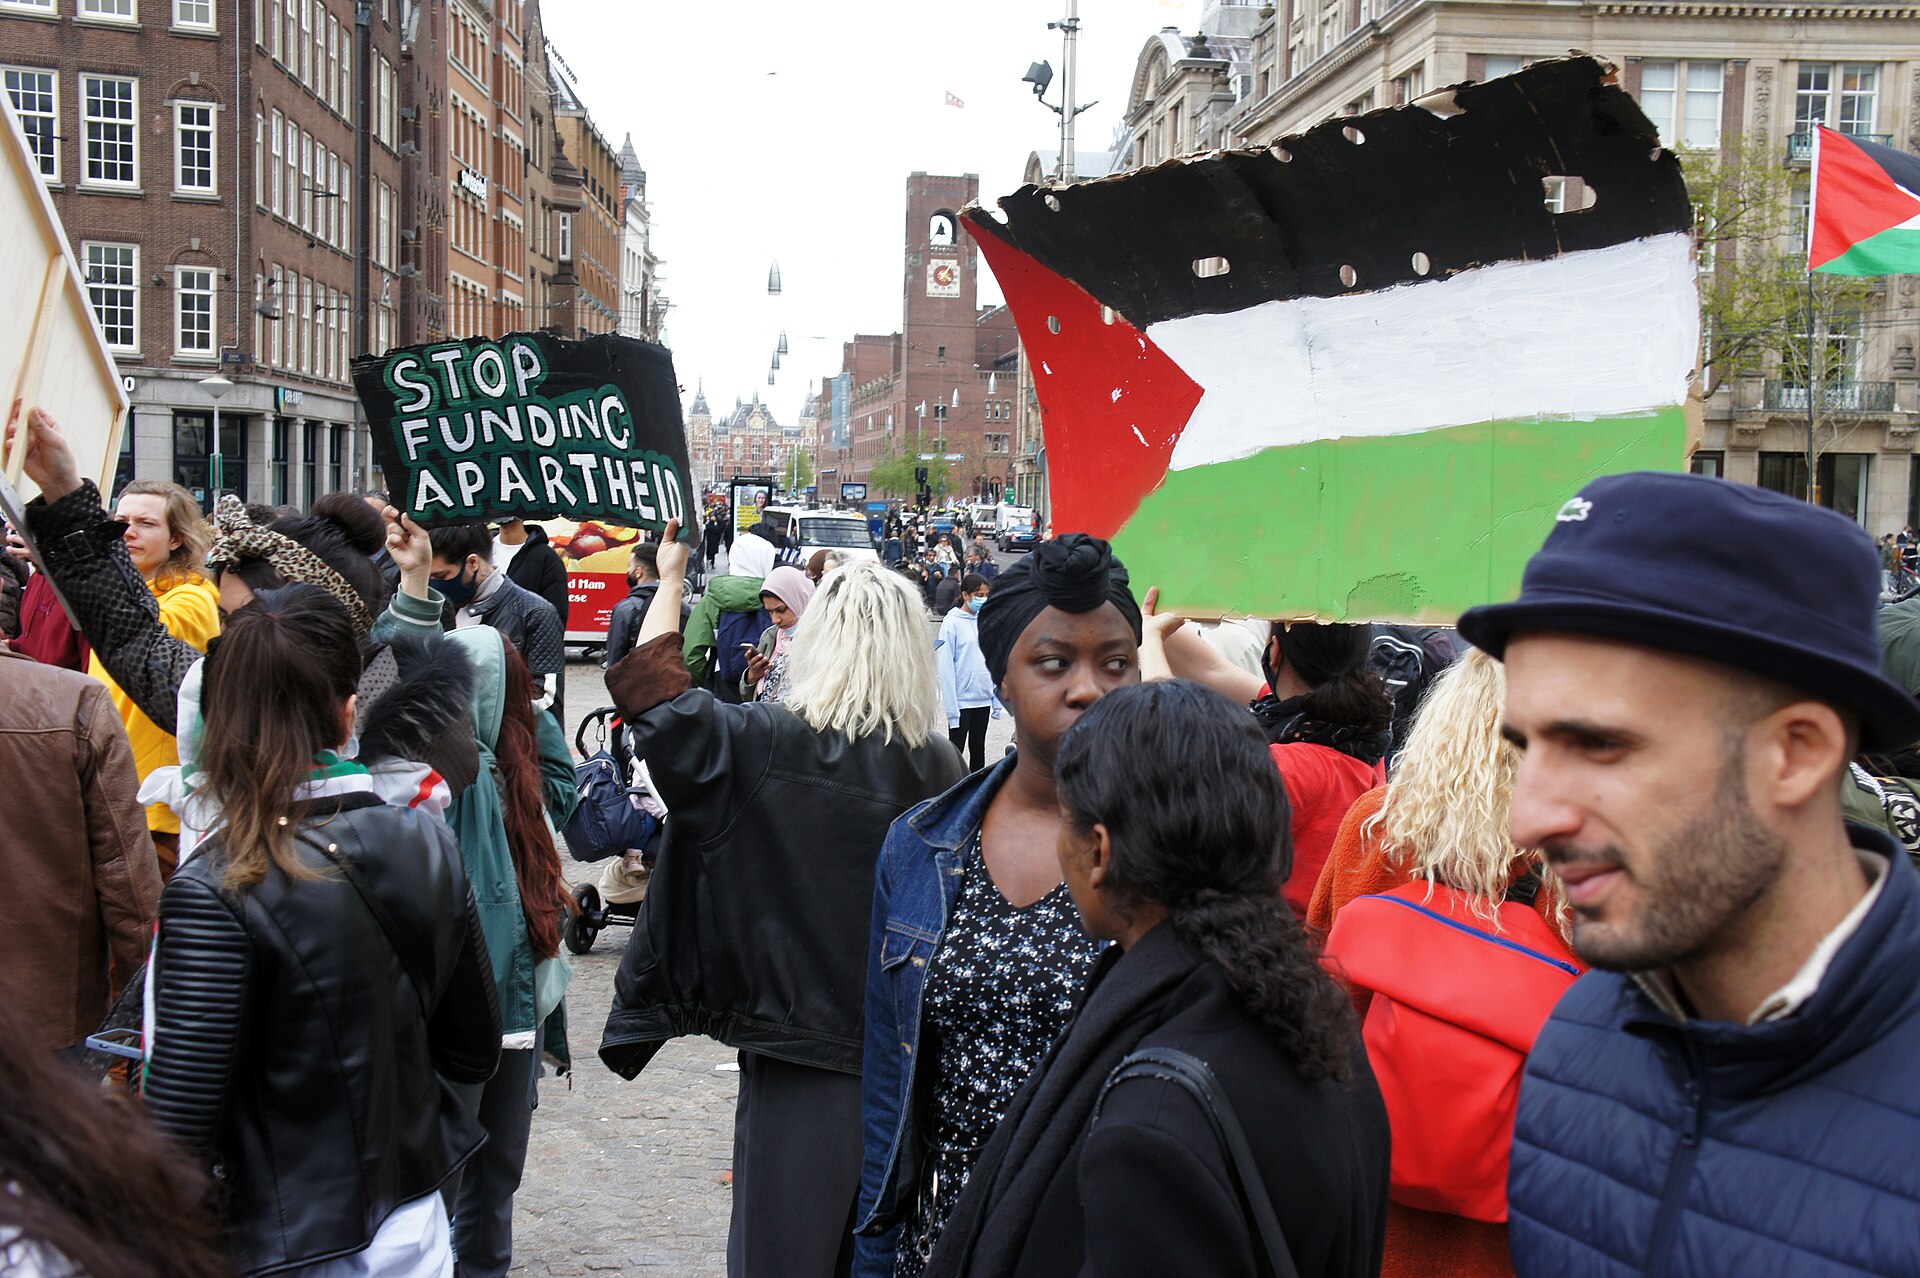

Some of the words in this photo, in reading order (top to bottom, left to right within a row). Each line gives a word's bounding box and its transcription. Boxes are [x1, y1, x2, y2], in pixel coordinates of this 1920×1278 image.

[393, 342, 543, 413] STOP
[401, 395, 630, 461] FUNDING
[414, 452, 684, 527] APARTHEID
